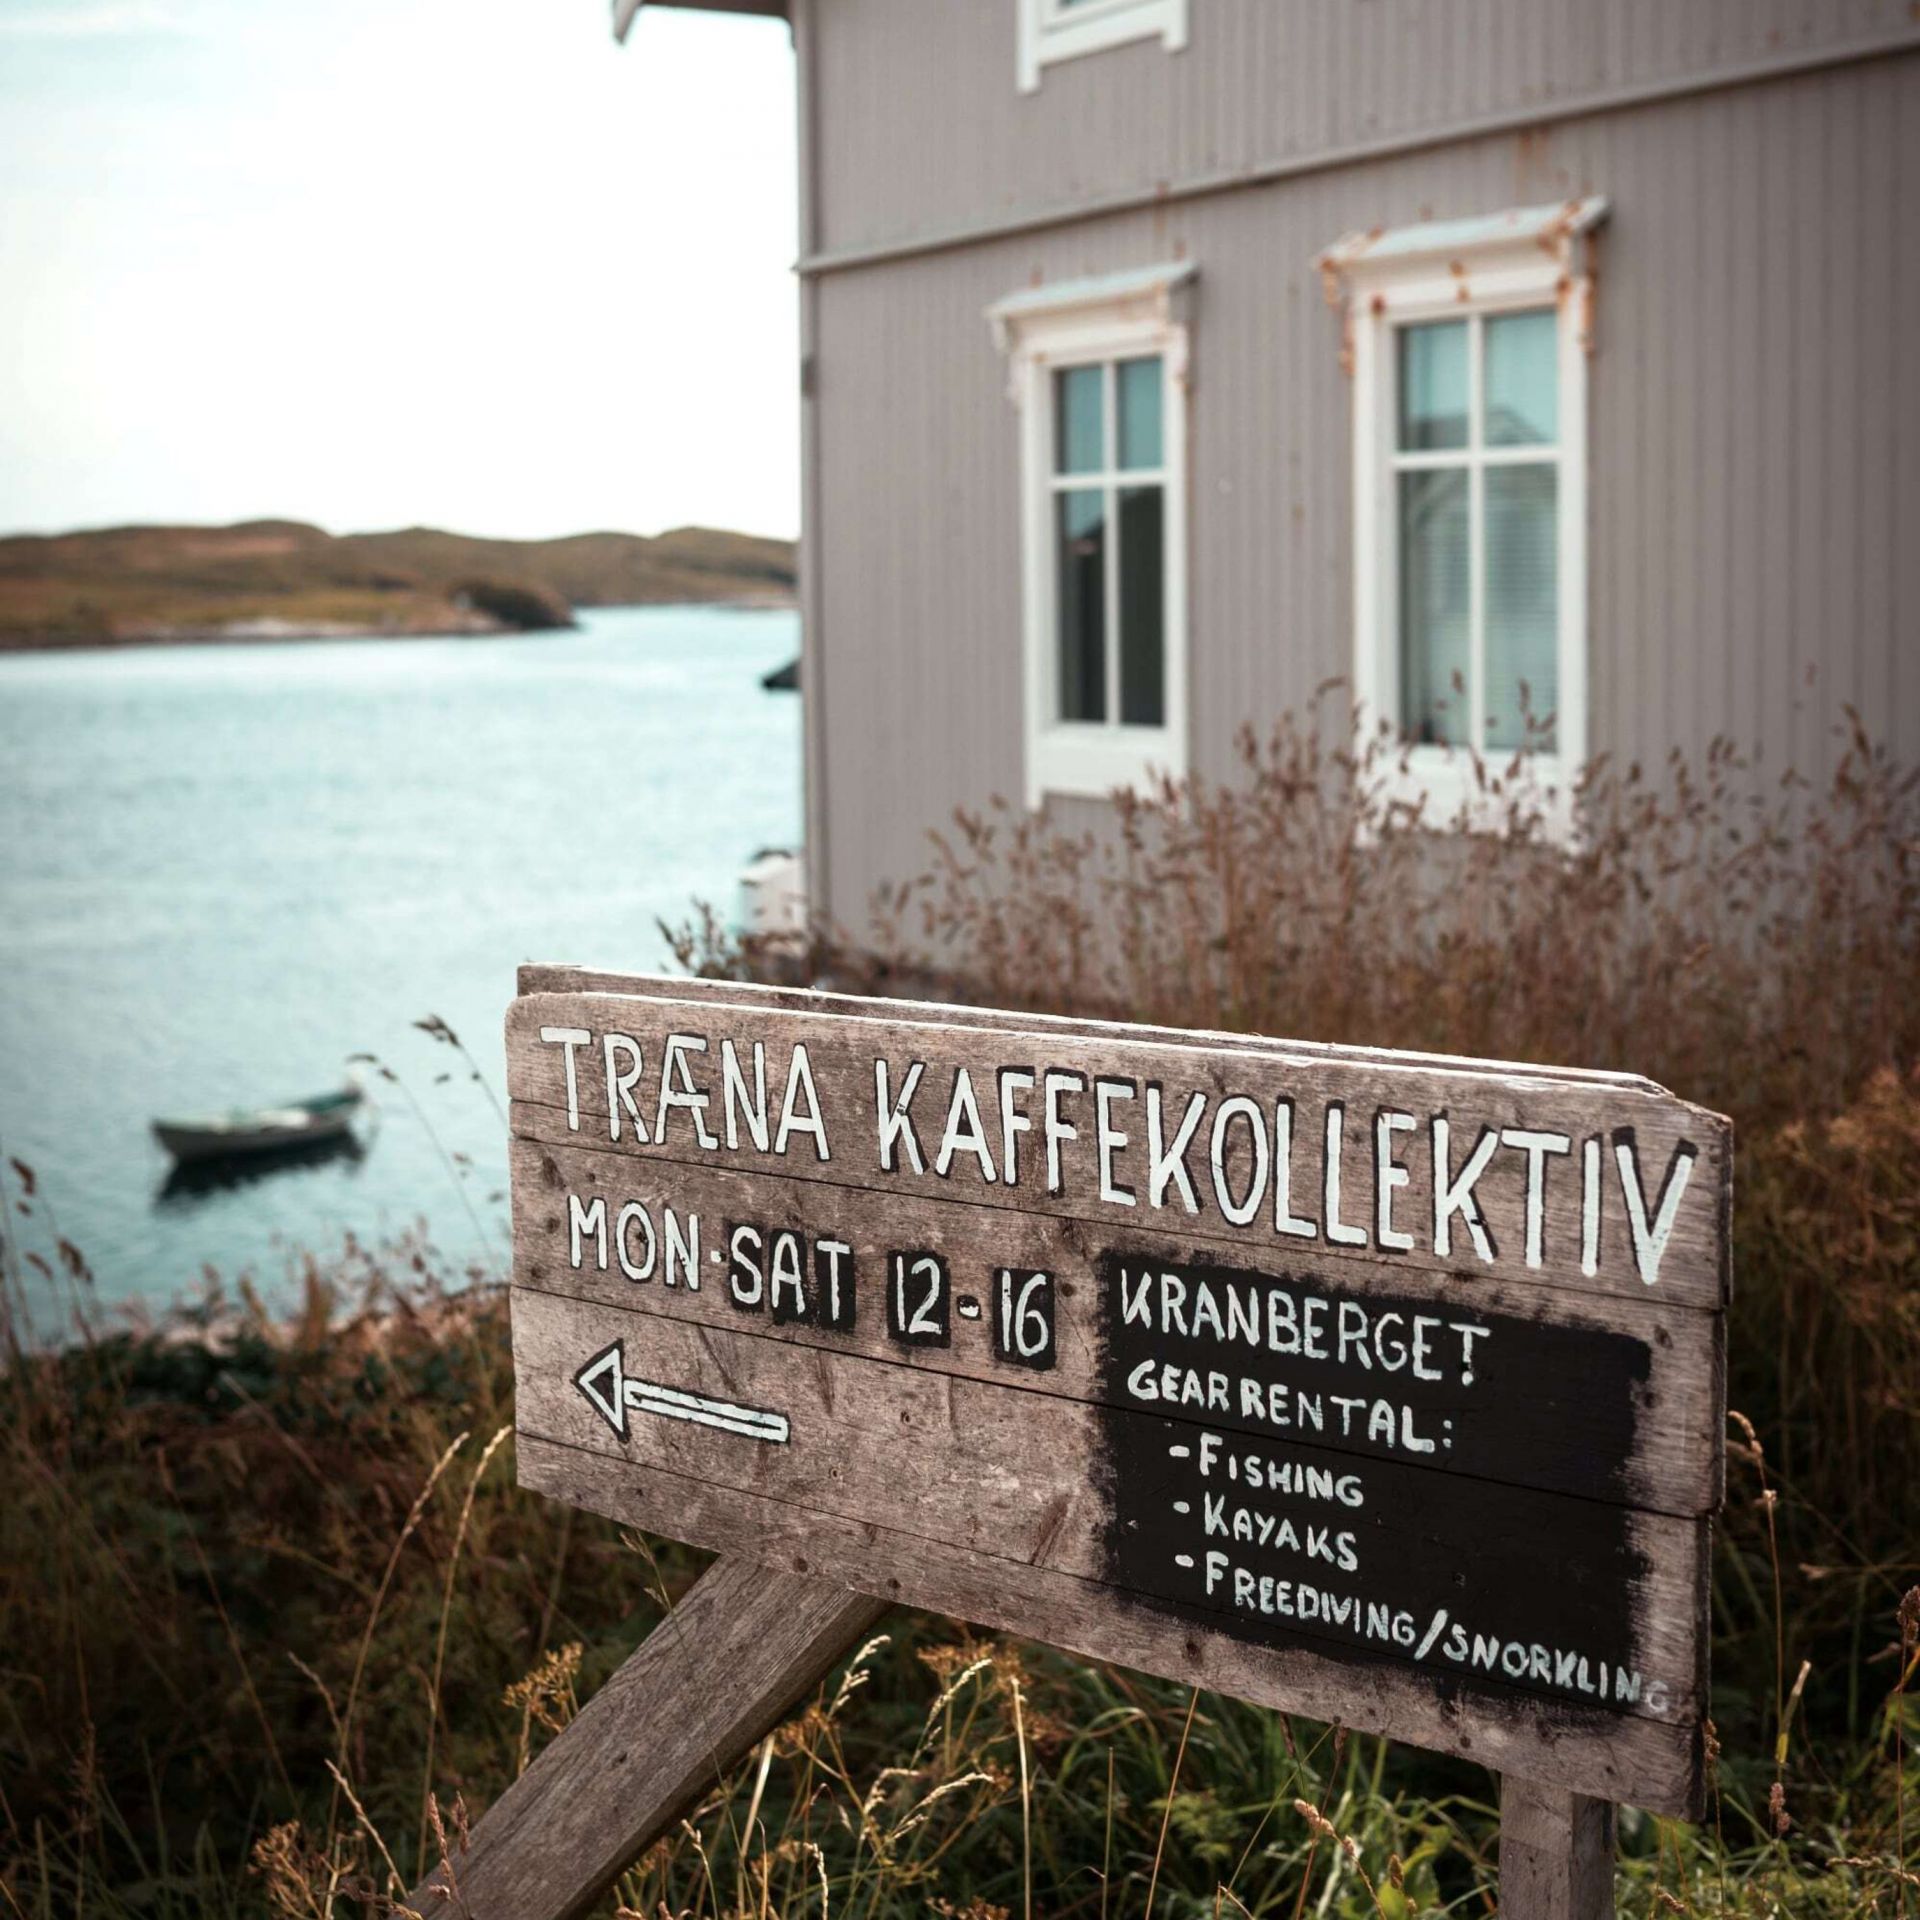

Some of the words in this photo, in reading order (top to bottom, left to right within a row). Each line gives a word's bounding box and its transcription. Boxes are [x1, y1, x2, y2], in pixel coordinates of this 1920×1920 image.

[539, 1025, 831, 1162] TRÆNA
[874, 1056, 1696, 1286] KAFFEKOLLEKTIV
[1120, 1268, 1492, 1386] KRANBERGET
